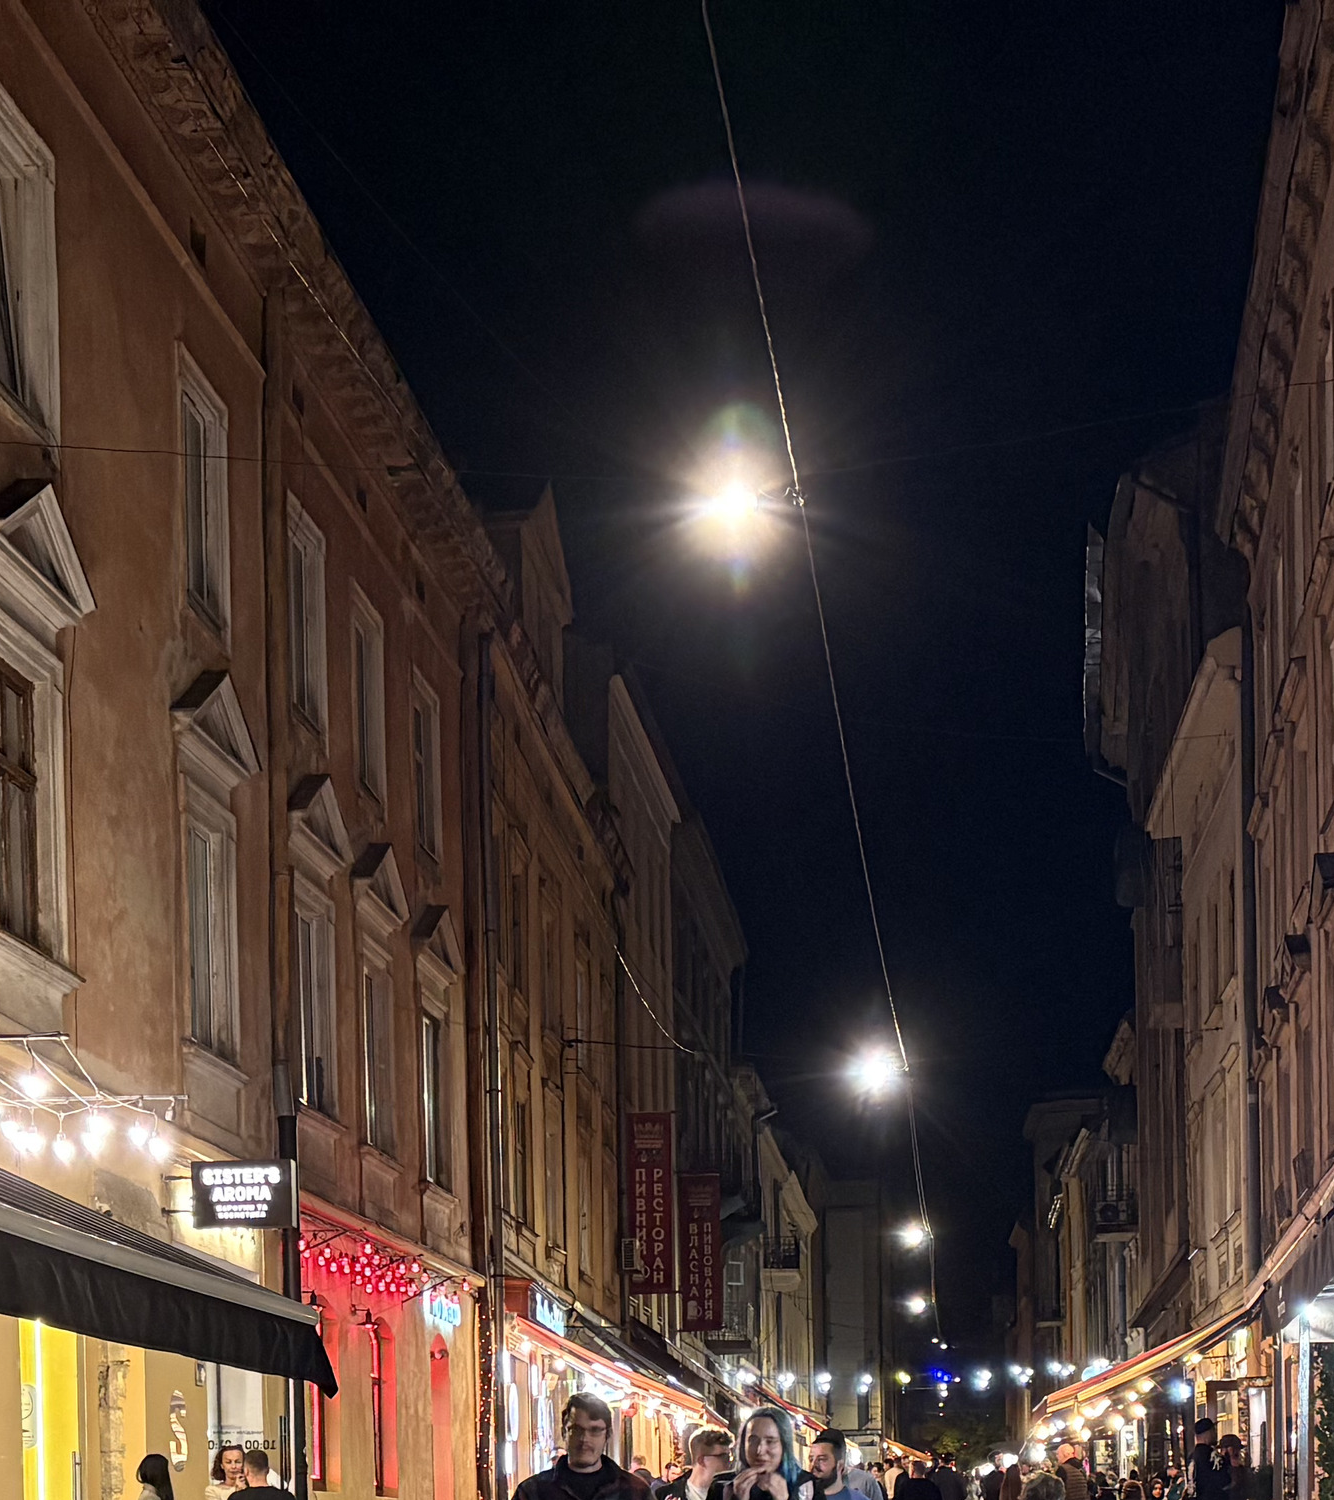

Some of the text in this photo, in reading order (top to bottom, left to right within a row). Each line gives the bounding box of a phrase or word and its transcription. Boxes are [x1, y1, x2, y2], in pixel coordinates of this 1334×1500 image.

[201, 1166, 281, 1186] SISTER'S
[212, 1185, 272, 1202] AROMA
[652, 1168, 665, 1285] РЕСТОРАН
[688, 1223, 699, 1297] ВЛАСНА
[703, 1221, 713, 1321] ПИВОВАРНЯ
